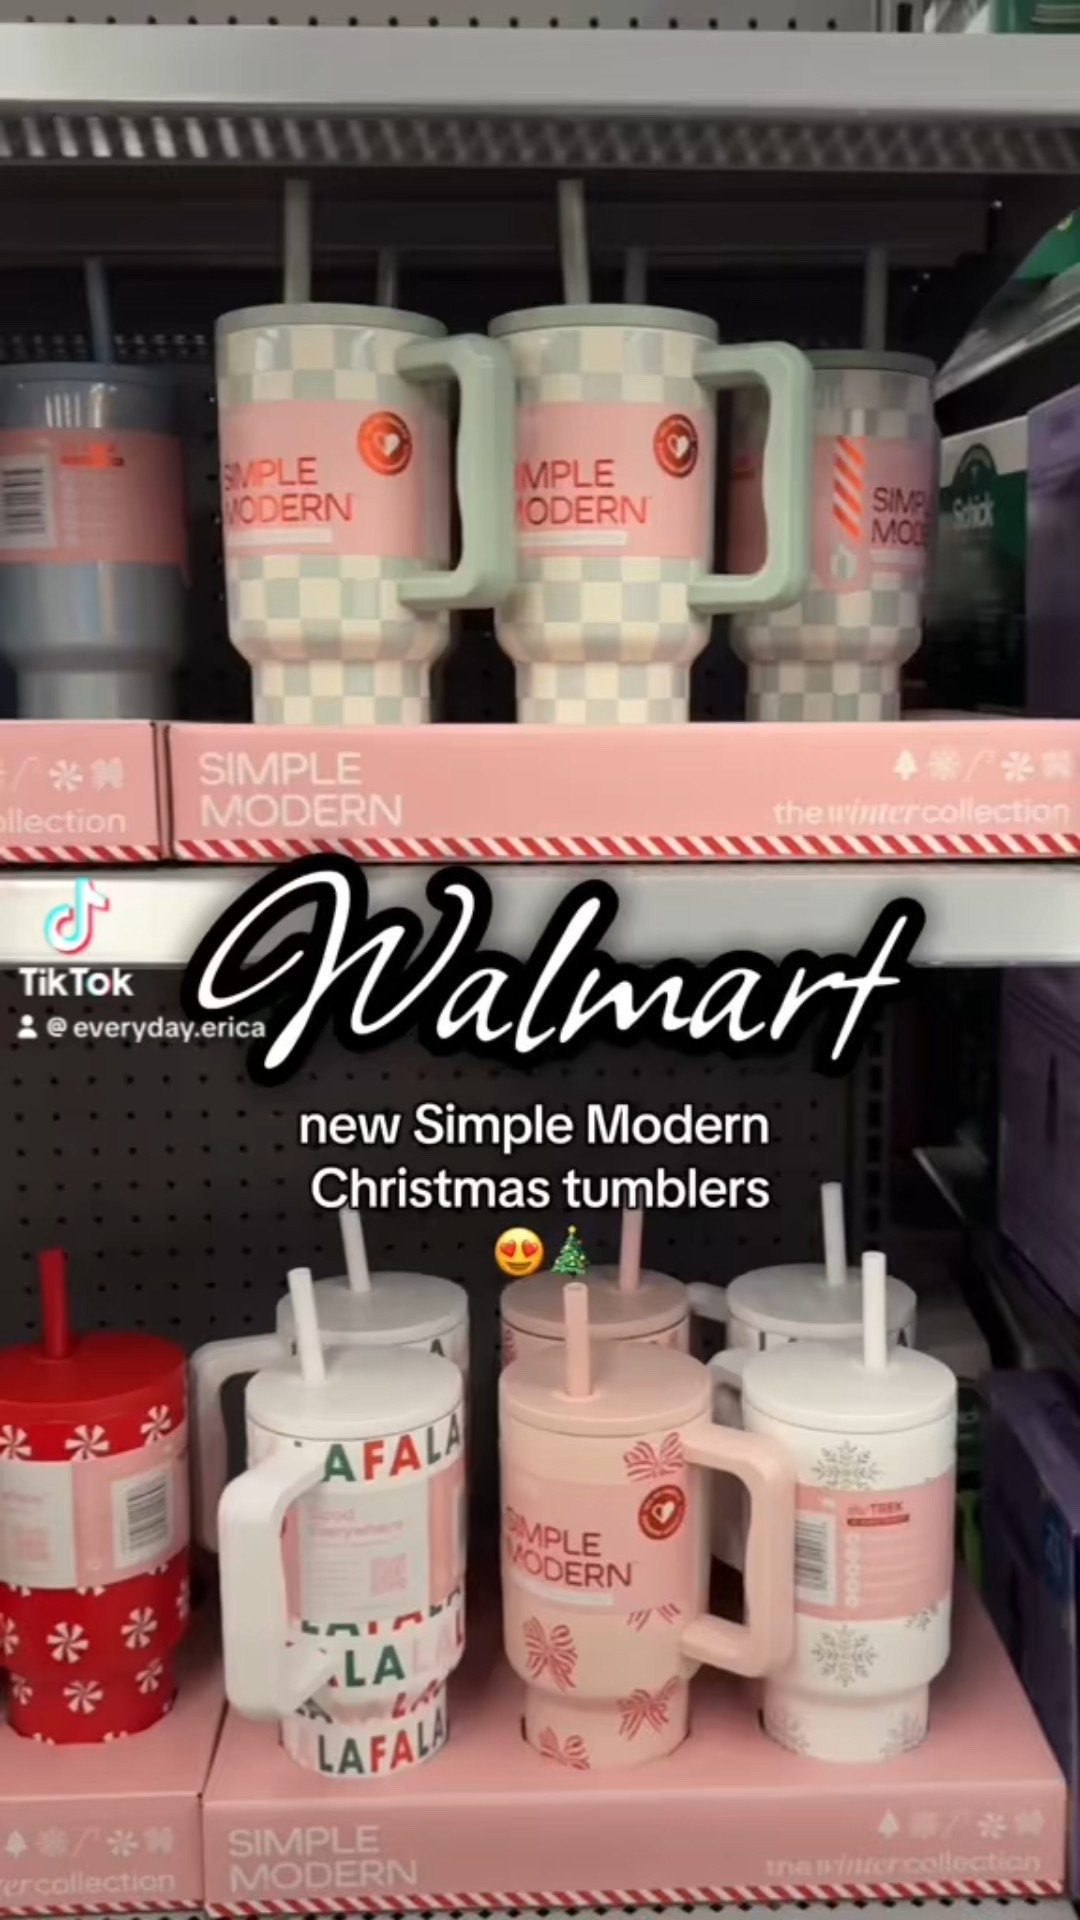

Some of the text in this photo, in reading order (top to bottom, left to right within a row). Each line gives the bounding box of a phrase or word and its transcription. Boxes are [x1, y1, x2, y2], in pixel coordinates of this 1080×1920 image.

[224, 457, 319, 491] SIMPLE
[515, 458, 616, 489] IMPLE
[518, 496, 648, 526] ODERN
[199, 751, 362, 787] SIMPLE
[201, 793, 402, 828] MODERN
[773, 798, 1070, 825] the winter collection
[229, 1825, 381, 1857] SIMPLE
[229, 1859, 419, 1892] MODERN
[901, 1851, 1042, 1876] collection
[35, 1869, 175, 1896] collection
